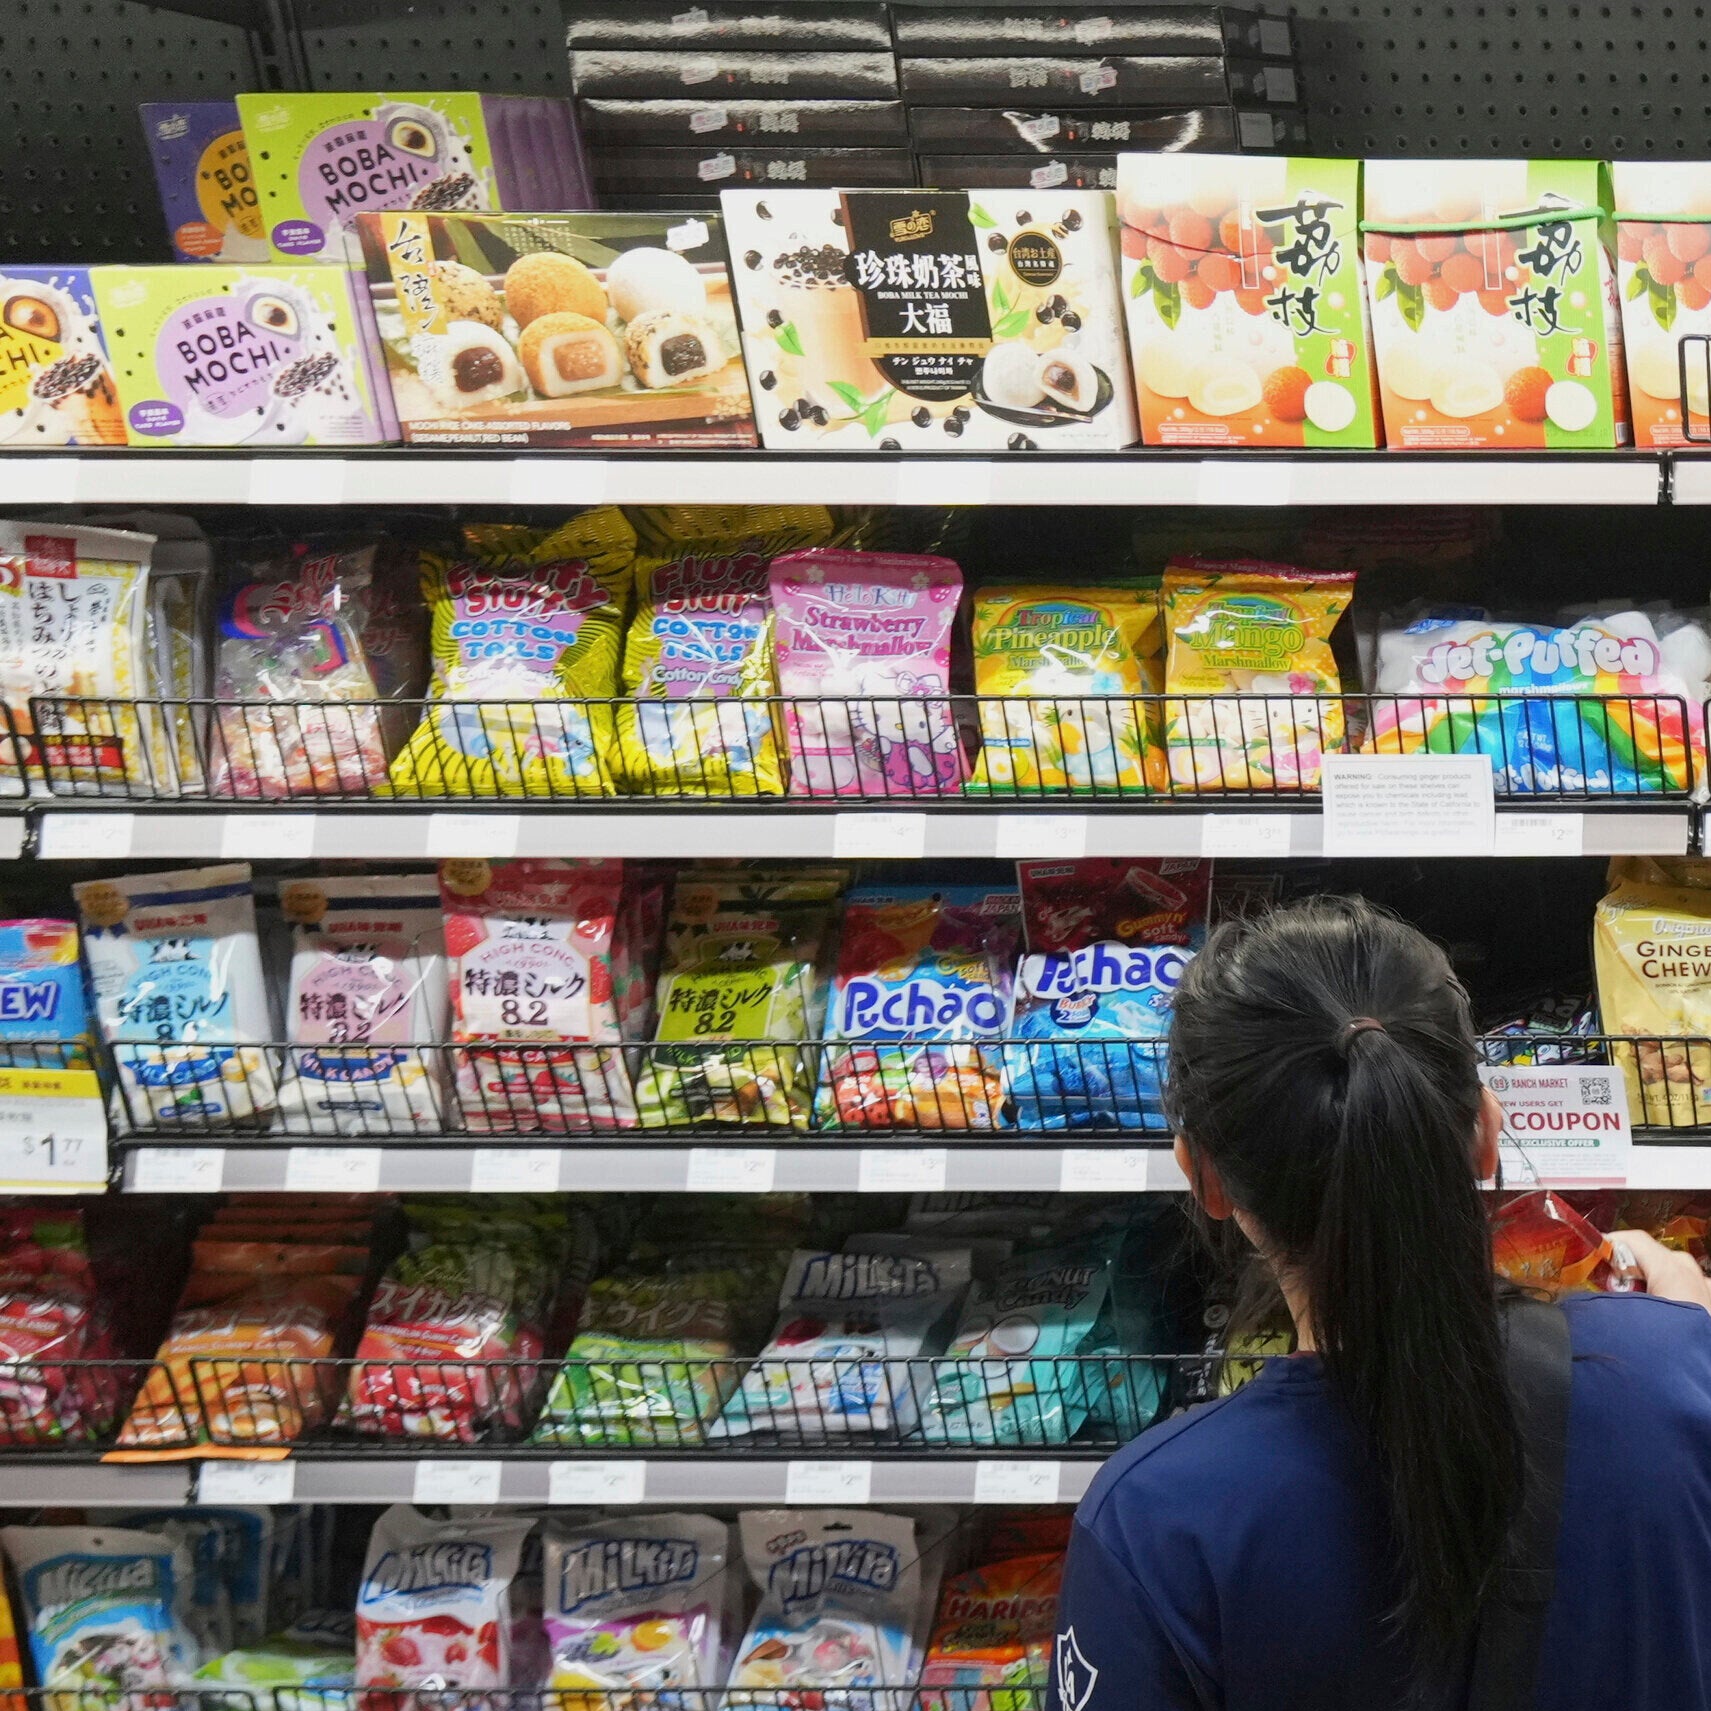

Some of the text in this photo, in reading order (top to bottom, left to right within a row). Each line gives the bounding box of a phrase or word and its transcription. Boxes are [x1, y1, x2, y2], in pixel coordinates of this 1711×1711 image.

[319, 143, 393, 186] BOBA
[898, 302, 953, 336] 大福
[177, 320, 256, 365] BOBA
[804, 606, 926, 637] Strawberry
[993, 625, 1117, 651] Pineapple
[464, 969, 587, 999] 特濃ミルク
[669, 984, 772, 1014] 特濃ミルク
[501, 1000, 549, 1027] 8.2
[1511, 1078, 1569, 1090] RANCH MARKET
[1509, 1111, 1621, 1132] COUPON
[1568, 1139, 1596, 1148] OFFER
